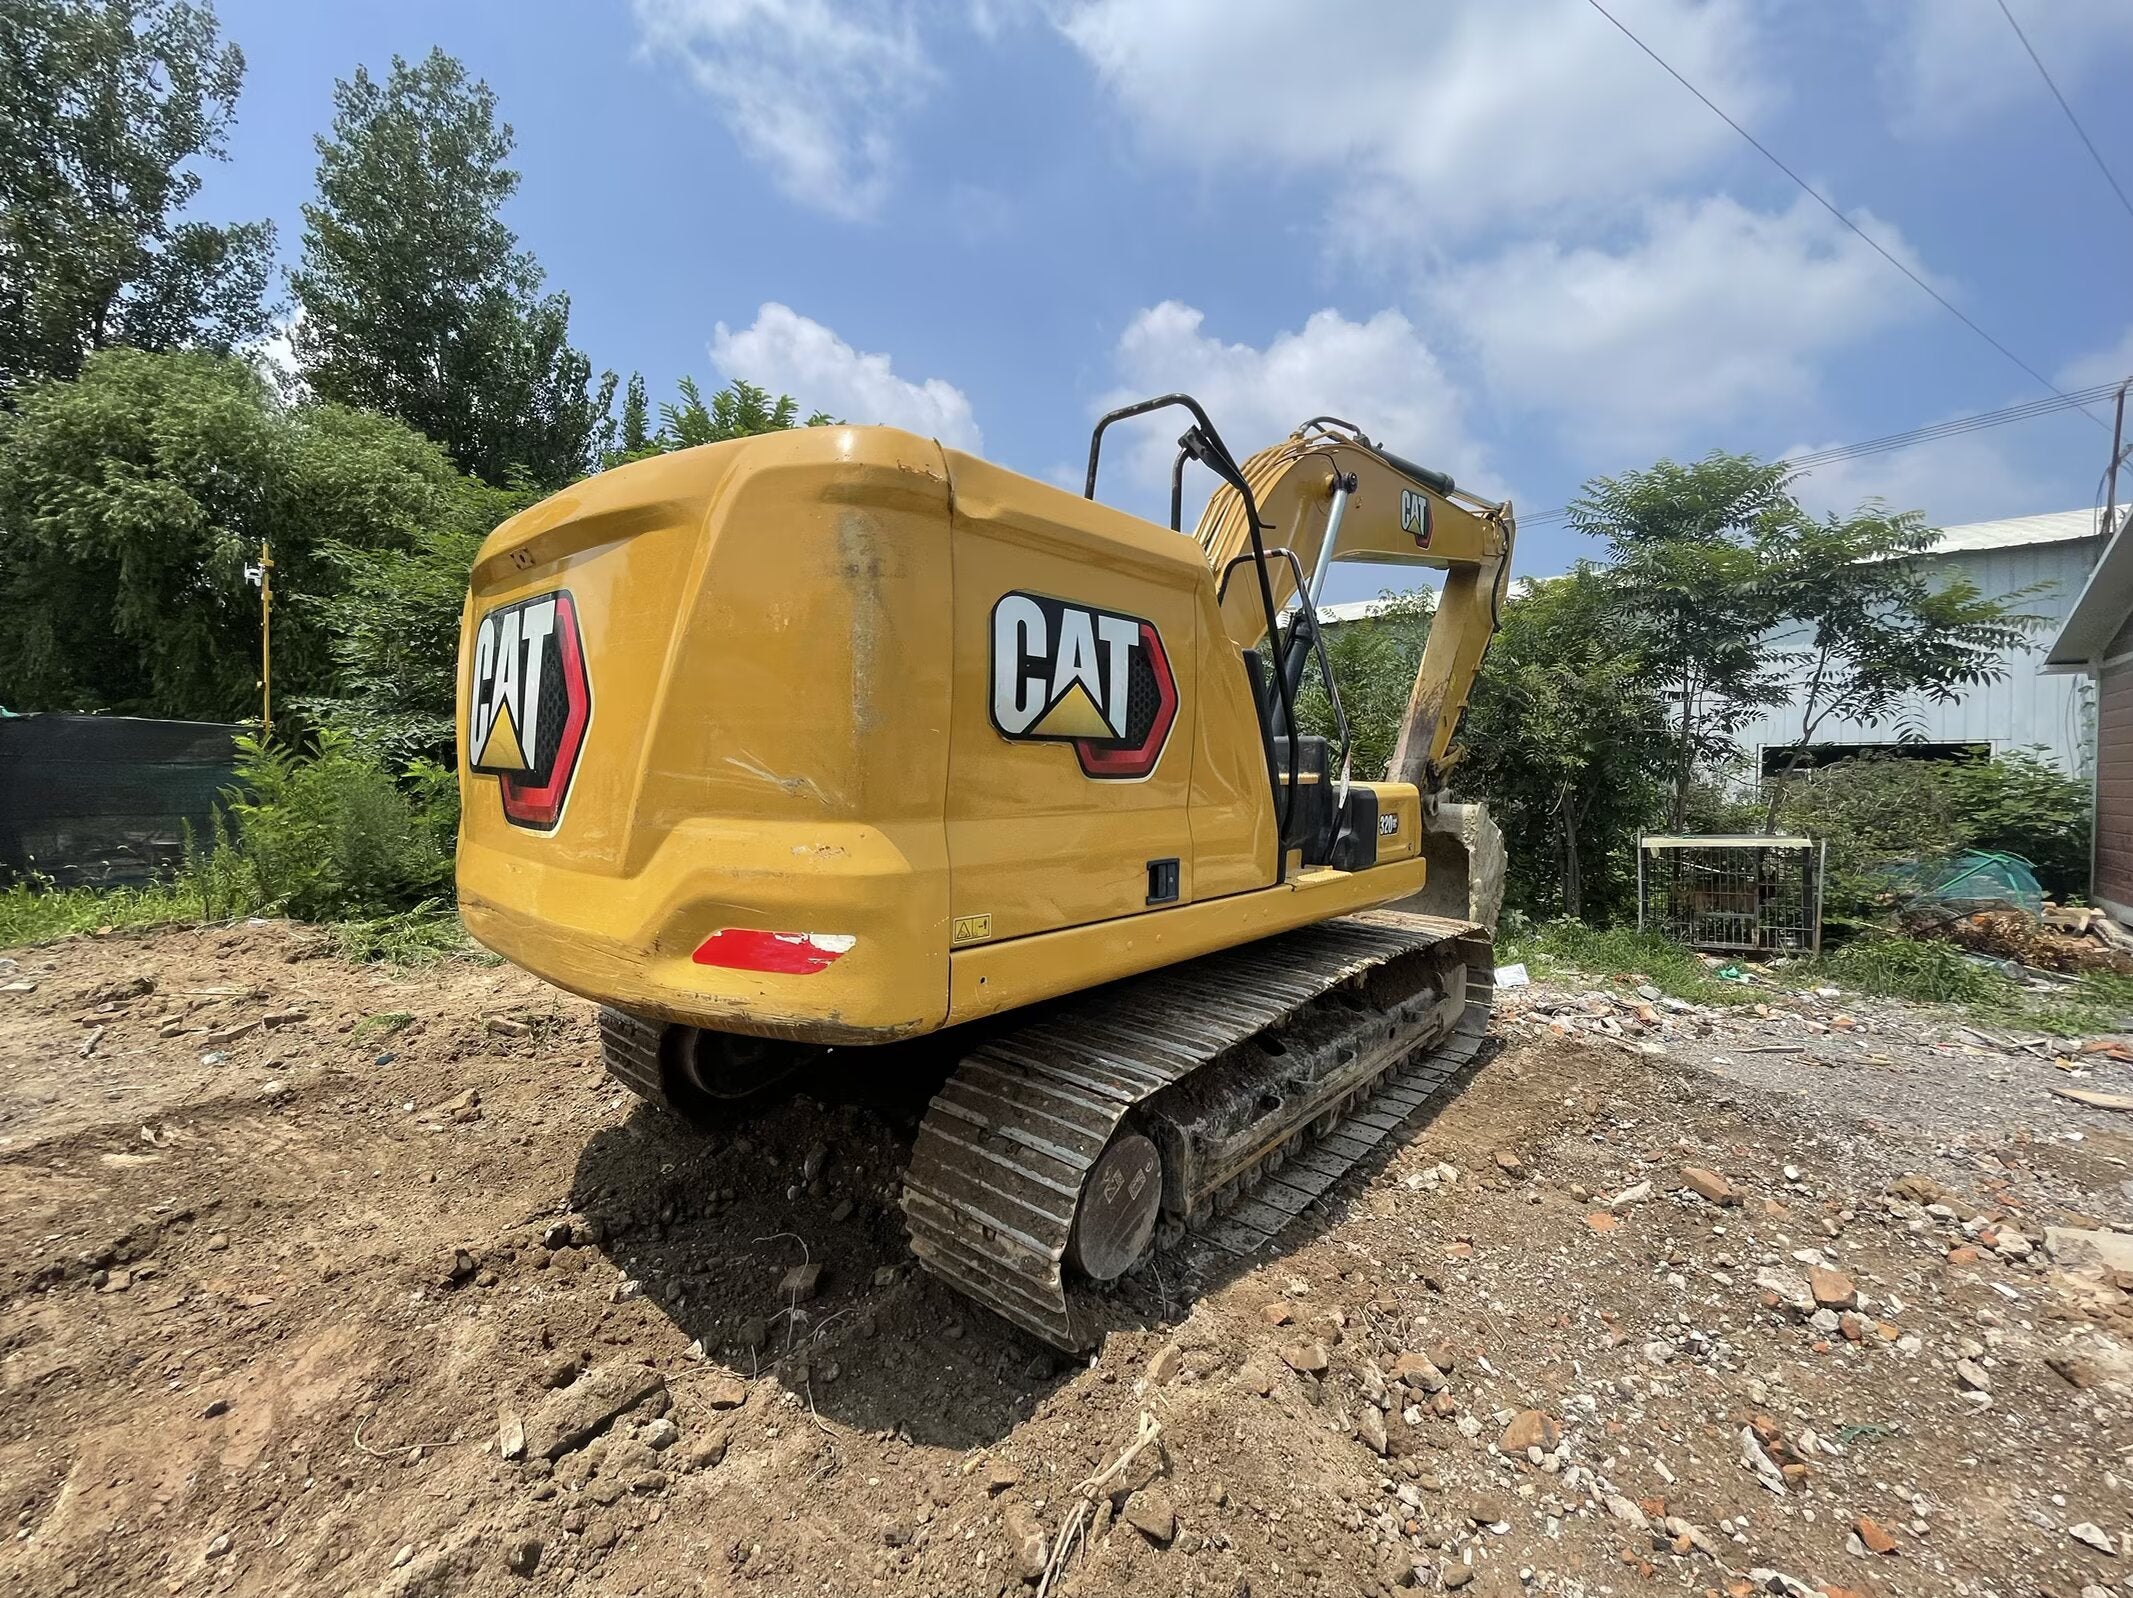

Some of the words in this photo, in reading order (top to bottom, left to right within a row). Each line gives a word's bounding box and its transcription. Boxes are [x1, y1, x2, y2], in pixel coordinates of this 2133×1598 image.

[1402, 490, 1426, 535] CAT
[470, 600, 556, 770] CAT
[995, 595, 1139, 738] CAT
